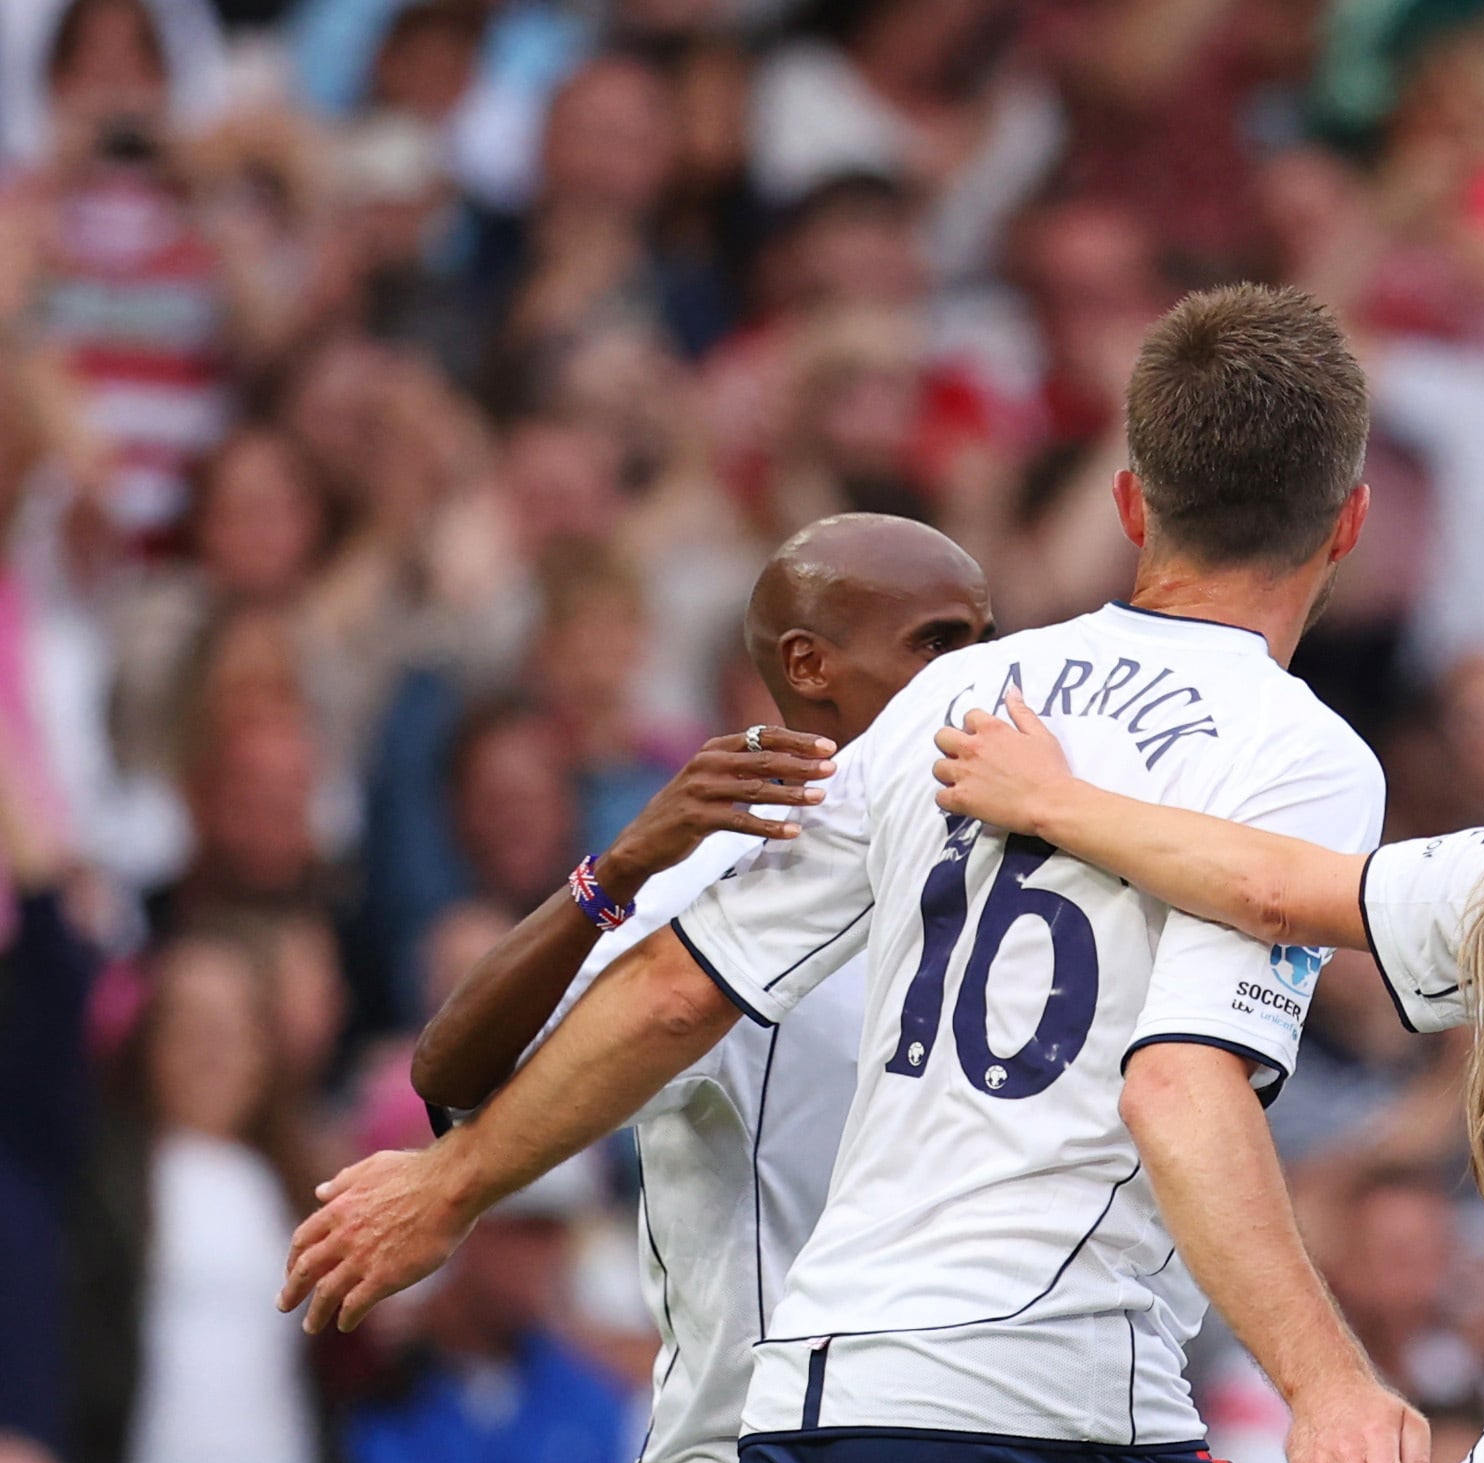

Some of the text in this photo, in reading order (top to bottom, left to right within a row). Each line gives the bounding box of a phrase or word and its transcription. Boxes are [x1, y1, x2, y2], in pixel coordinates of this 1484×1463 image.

[943, 657, 1218, 772] CARRICK
[886, 812, 1099, 1099] 16
[1236, 981, 1302, 1021] SOCCER
